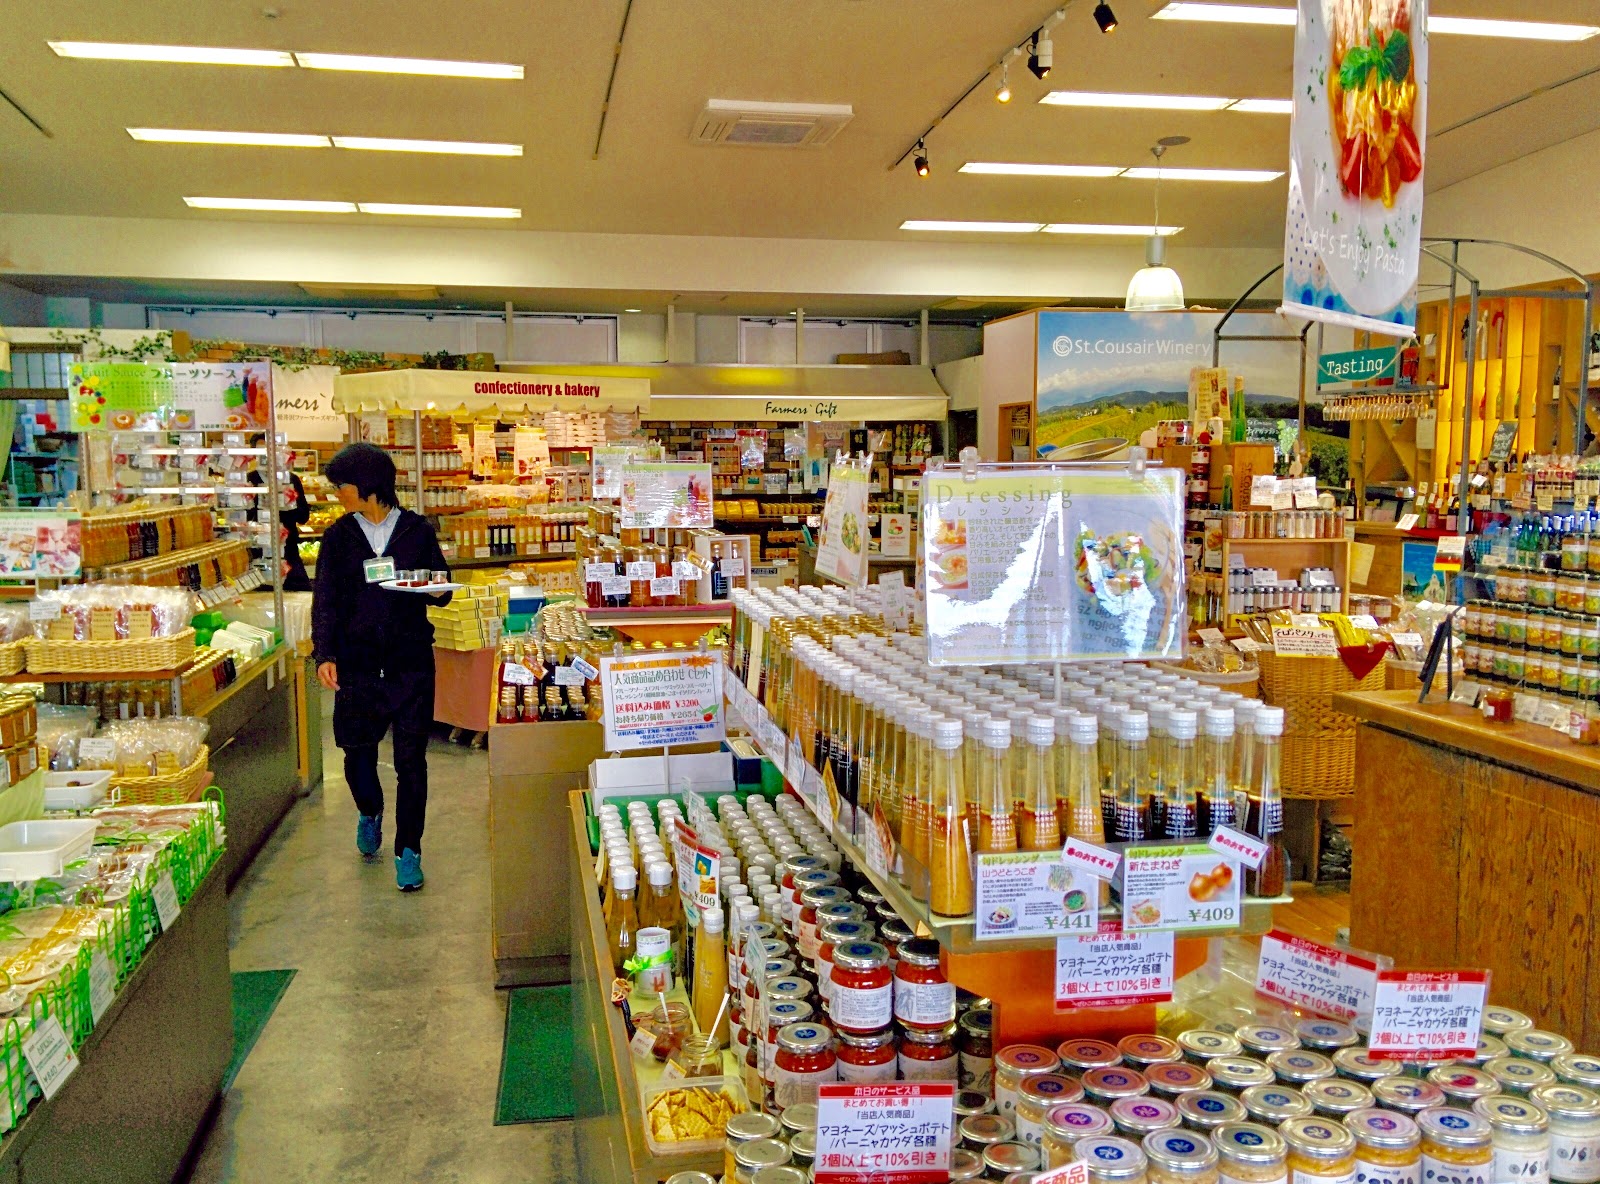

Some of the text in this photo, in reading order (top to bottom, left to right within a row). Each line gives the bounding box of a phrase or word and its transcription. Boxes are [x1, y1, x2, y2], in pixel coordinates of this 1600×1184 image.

[1303, 222, 1405, 276] Let's Enjoy Pasta
[1156, 338, 1211, 357] Winery
[82, 367, 146, 378] Fruit Sauce
[1326, 356, 1384, 377] Tasting
[474, 380, 600, 399] confectionery & bakery
[815, 401, 838, 416] Gift
[937, 484, 1073, 508] Dressing
[615, 700, 670, 713] 送料込み価格
[1066, 847, 1116, 870] 春のおすすめ
[1129, 859, 1182, 871] 新たまねぎ
[982, 866, 1037, 878] 山うどとうこぎ
[1044, 914, 1092, 930] ¥441
[1188, 908, 1234, 922] ¥409
[1059, 952, 1172, 968] マヨネーズ/マッシュポテト
[1068, 963, 1161, 978] /バーニャカウダ各種
[1261, 957, 1370, 1000] マヨネーズ/マッシュポテト
[1268, 968, 1359, 1008] /バーニャカウダ各種
[1375, 1005, 1481, 1018] マヨネーズ/マッシュポテト
[1382, 1017, 1468, 1028] /バーニャカウダ各種
[853, 1086, 921, 1096] 本日のサービス品
[856, 1109, 915, 1120] 「当店人気商品」
[819, 1122, 950, 1138] マヨネーズ/マッシュポテト
[829, 1135, 937, 1149] /バーニャカウダ各種
